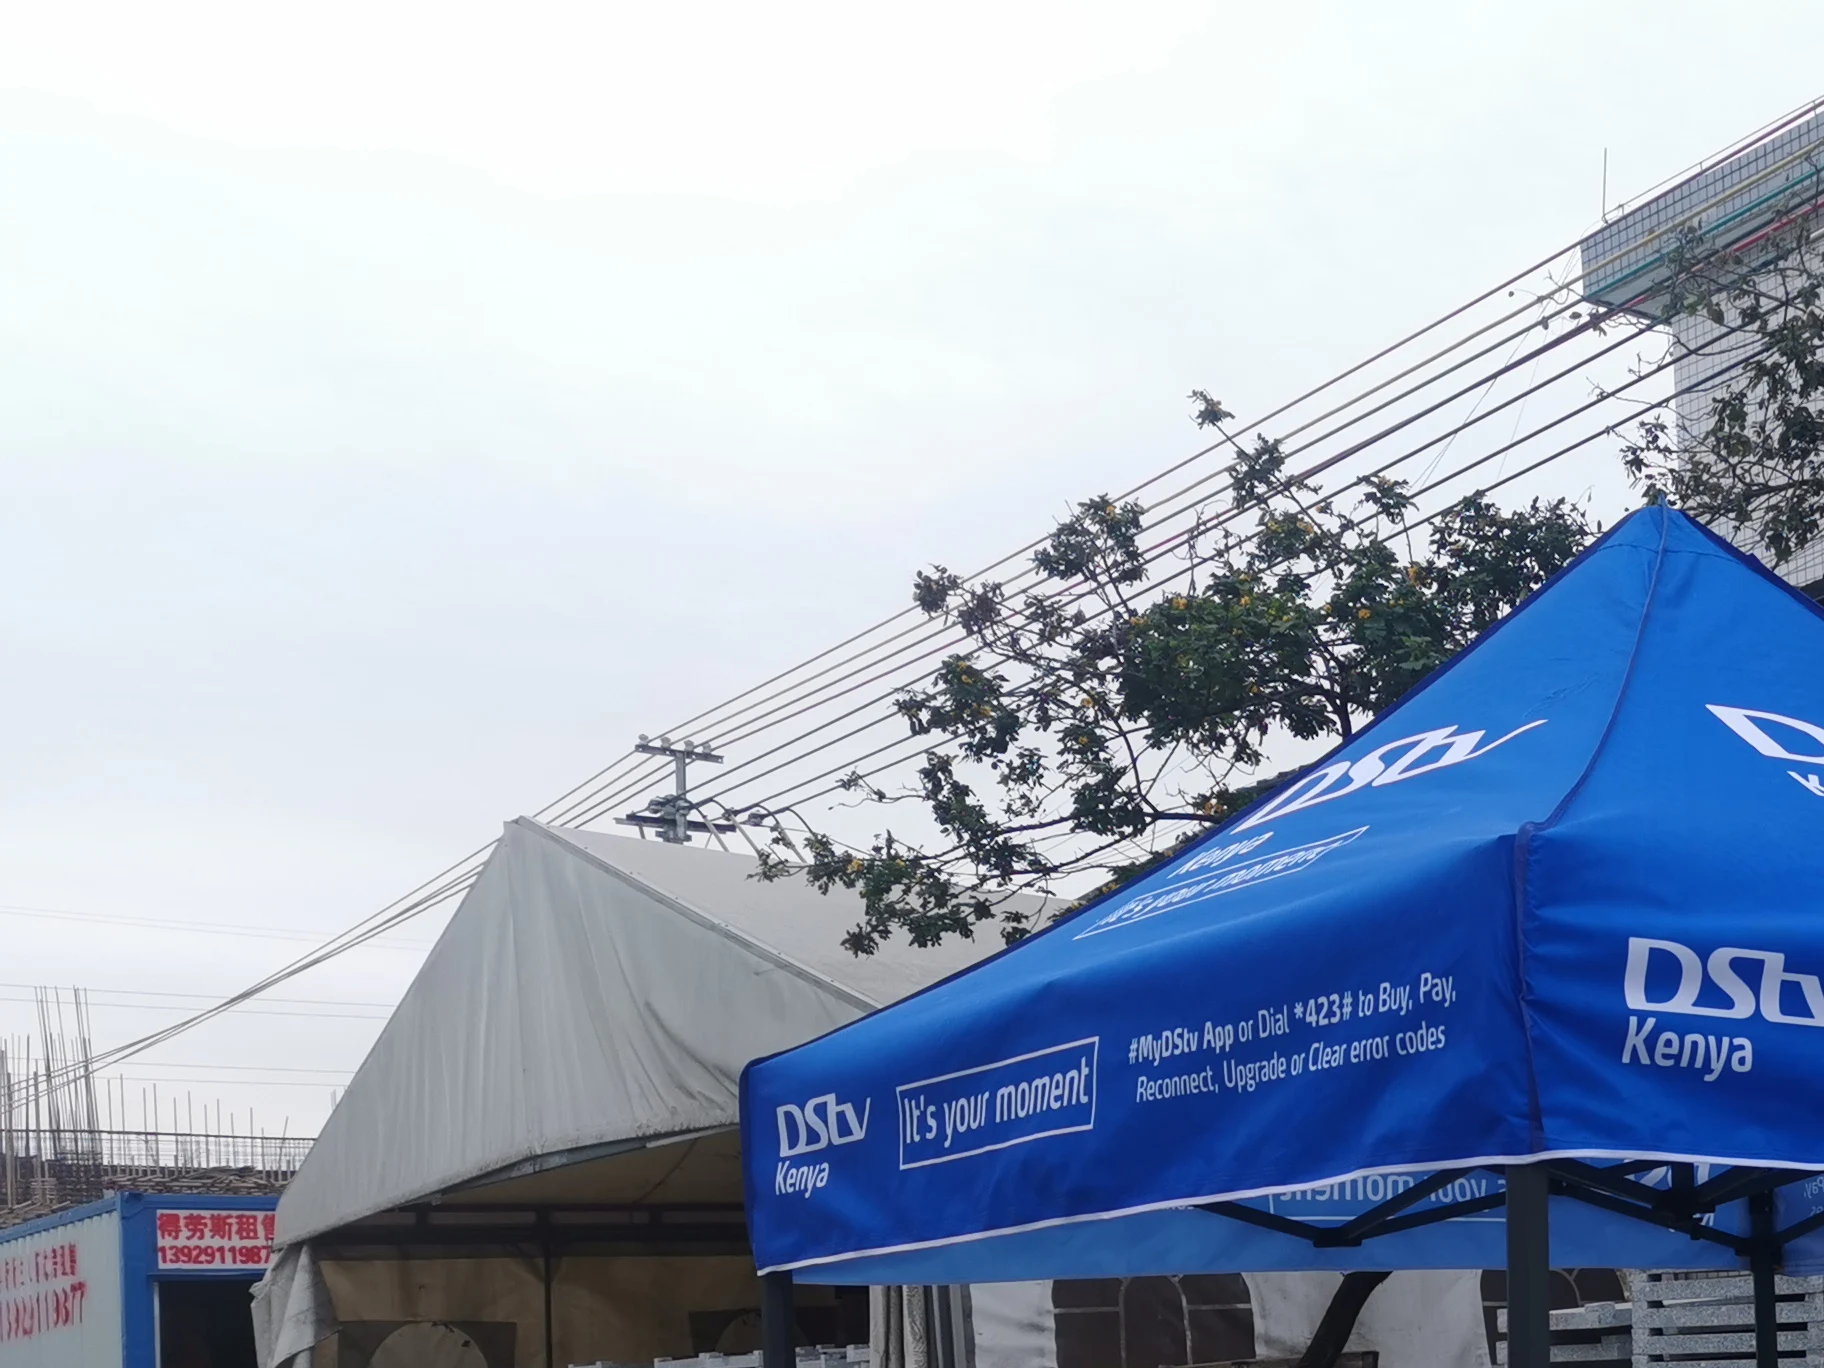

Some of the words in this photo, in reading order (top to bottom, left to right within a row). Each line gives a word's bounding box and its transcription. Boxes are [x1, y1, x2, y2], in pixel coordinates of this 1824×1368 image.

[1128, 1028, 1198, 1067] #MyDStv
[1203, 1021, 1234, 1054] App
[1239, 1020, 1253, 1042] or
[1258, 1004, 1289, 1038] Dial
[1358, 990, 1374, 1018] to
[1378, 982, 1412, 1015] Buy,
[1420, 972, 1456, 1007] Pay,
[1621, 1016, 1753, 1082] Kenya
[1136, 1065, 1219, 1103] Reconnect,
[1223, 1051, 1286, 1093] Upgrade
[1291, 1052, 1305, 1076] or
[1309, 1041, 1347, 1071] Clear
[1350, 1035, 1389, 1063] error
[1396, 1020, 1445, 1055] codes
[776, 1093, 871, 1157] DStv
[904, 1094, 937, 1144] It's
[943, 1090, 990, 1148] your
[995, 1056, 1090, 1123] moment
[775, 1162, 830, 1199] Kenya
